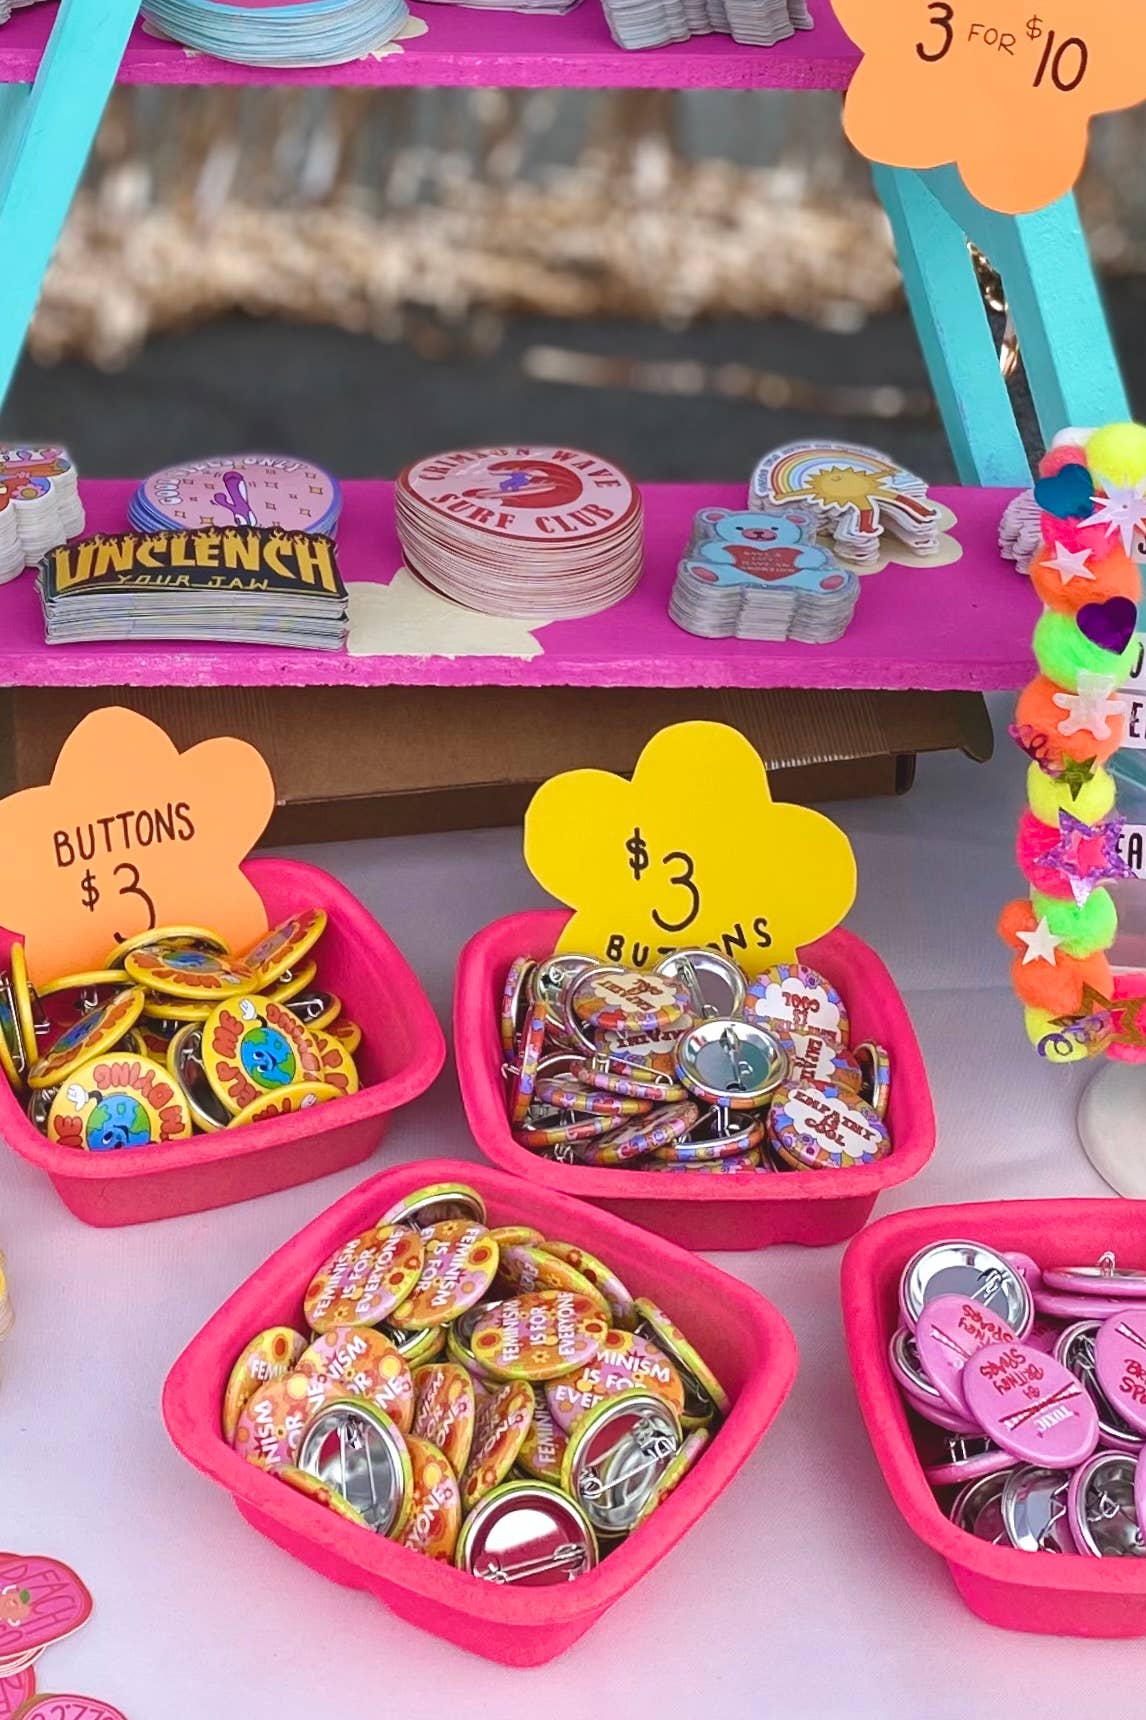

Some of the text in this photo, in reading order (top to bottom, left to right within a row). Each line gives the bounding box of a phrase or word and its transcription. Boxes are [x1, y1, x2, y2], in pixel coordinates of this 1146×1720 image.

[916, 1, 1088, 92] 3 FOR $10
[551, 449, 622, 489] WAVE
[430, 493, 615, 534] SURF CLUB
[53, 528, 338, 593] UNCLENCH
[117, 574, 269, 591] YOUR JAW
[53, 801, 196, 868] BUTTONS
[626, 827, 700, 932] $3
[606, 917, 773, 967] BUNS
[92, 1061, 175, 1110] DYING
[215, 1060, 263, 1109] ELP
[794, 1090, 876, 1142] EMPATHY
[341, 1247, 377, 1300] IS FOR
[355, 1229, 404, 1314] EVERYONE
[431, 1227, 481, 1307] FEMINISM
[434, 1240, 449, 1256] IS
[312, 1237, 362, 1319] FEMINISM
[417, 1258, 443, 1292] FOR
[502, 1299, 521, 1362] FEMINISM
[530, 1304, 548, 1347] IS FOR
[557, 1291, 576, 1357] EVERYONE
[583, 1367, 601, 1384] IS
[595, 1349, 672, 1384] MINISM
